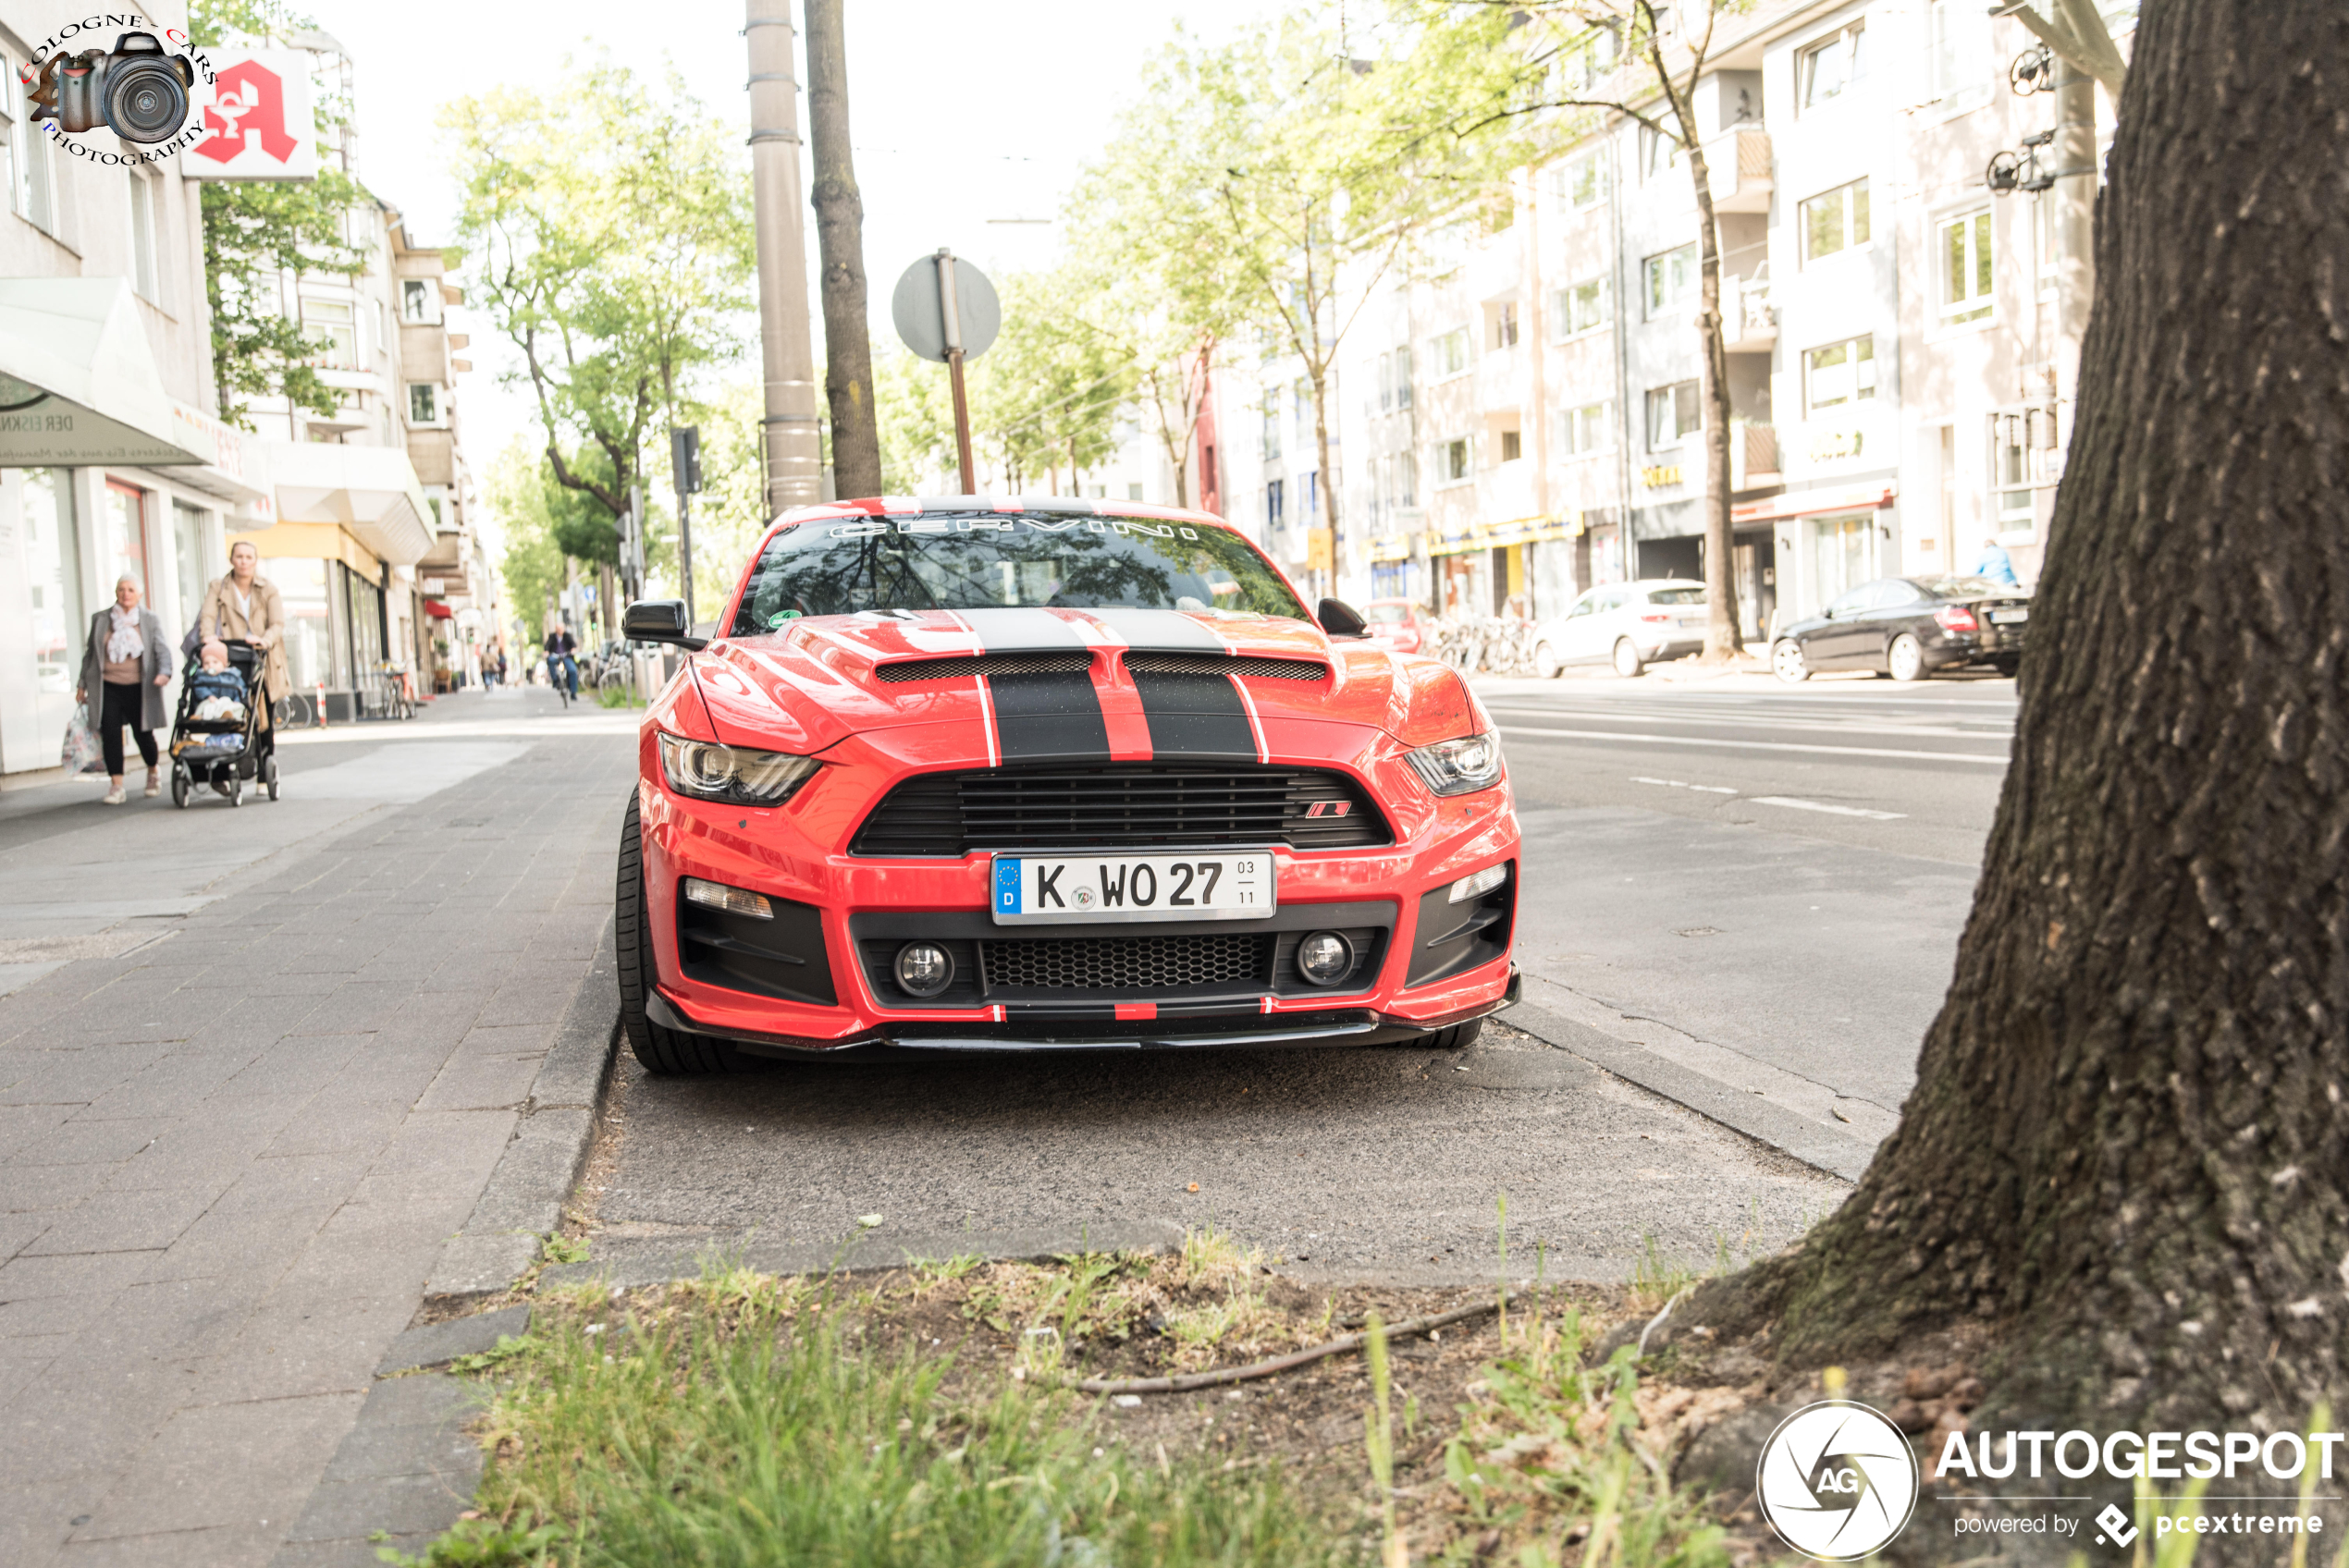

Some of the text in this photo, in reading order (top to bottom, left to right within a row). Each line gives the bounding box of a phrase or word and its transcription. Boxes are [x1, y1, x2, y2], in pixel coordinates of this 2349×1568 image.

[830, 518, 1199, 541] CERVINI
[1237, 862, 1254, 874] 03
[1003, 893, 1014, 905] D
[1038, 865, 1065, 908] K
[1100, 864, 1157, 907] WO
[1169, 863, 1223, 906] 27
[1239, 892, 1253, 904] 11
